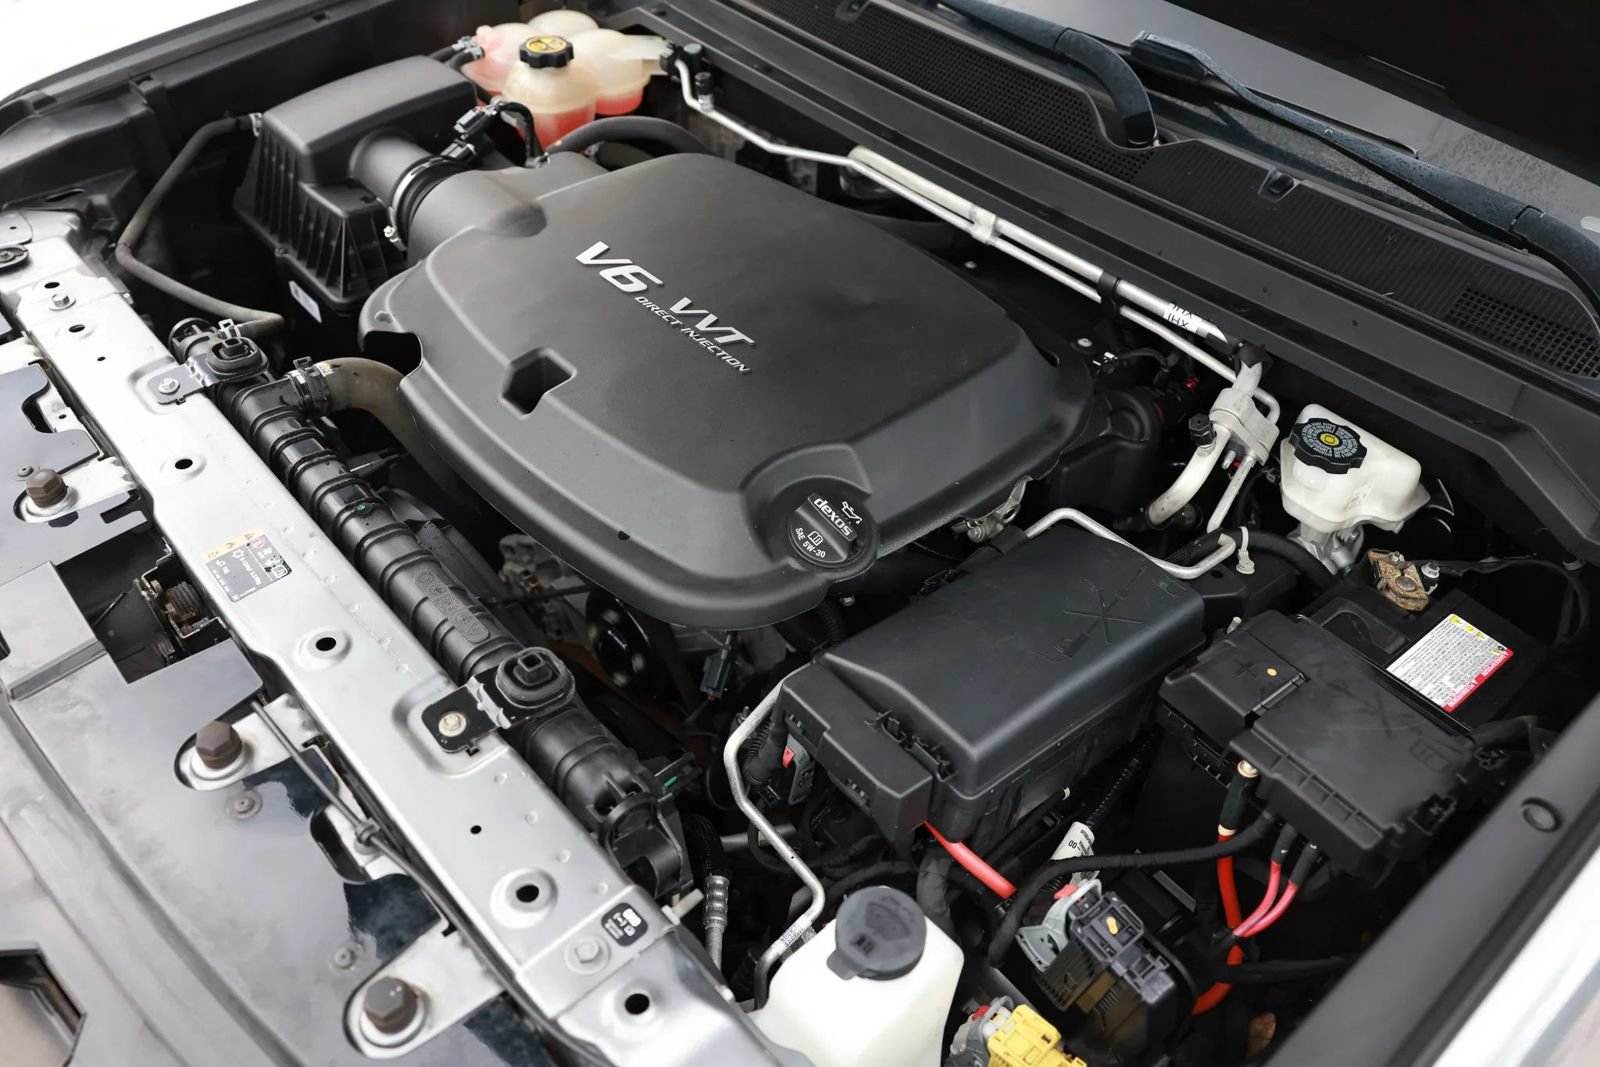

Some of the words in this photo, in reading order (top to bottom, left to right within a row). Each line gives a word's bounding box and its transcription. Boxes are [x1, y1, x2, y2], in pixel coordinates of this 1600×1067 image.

[575, 241, 664, 293] V6
[669, 297, 756, 345] VVT
[634, 296, 684, 326] DIRECT
[680, 327, 752, 374] INJECTION
[795, 528, 806, 541] SAE
[803, 541, 826, 558] 5W-30
[813, 498, 853, 536] dexos
